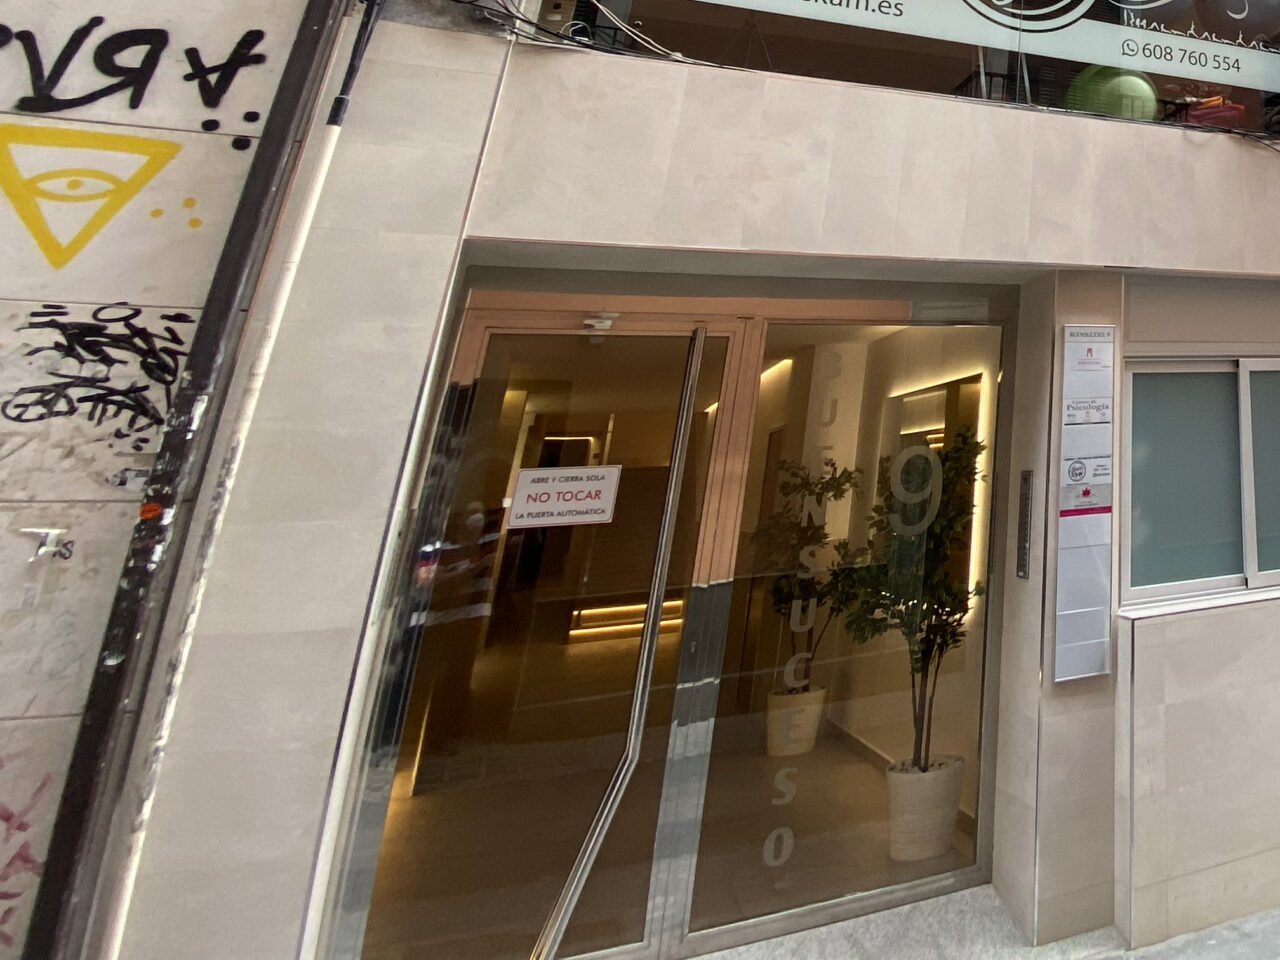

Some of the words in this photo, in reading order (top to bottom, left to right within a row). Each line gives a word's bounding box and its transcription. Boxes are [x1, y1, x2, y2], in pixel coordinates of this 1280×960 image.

[1142, 42, 1174, 62] 608
[1178, 48, 1208, 68] 760
[1212, 54, 1241, 73] 554
[530, 476, 550, 484] ABRE
[558, 475, 583, 483] CIERRA
[586, 474, 605, 482] SOLA
[526, 492, 551, 504] NO
[556, 489, 602, 503] TOCAR
[889, 444, 943, 536] 9
[515, 512, 525, 520] LA
[526, 511, 555, 519] PUERTA
[556, 507, 606, 518] AUTOMÁTICA
